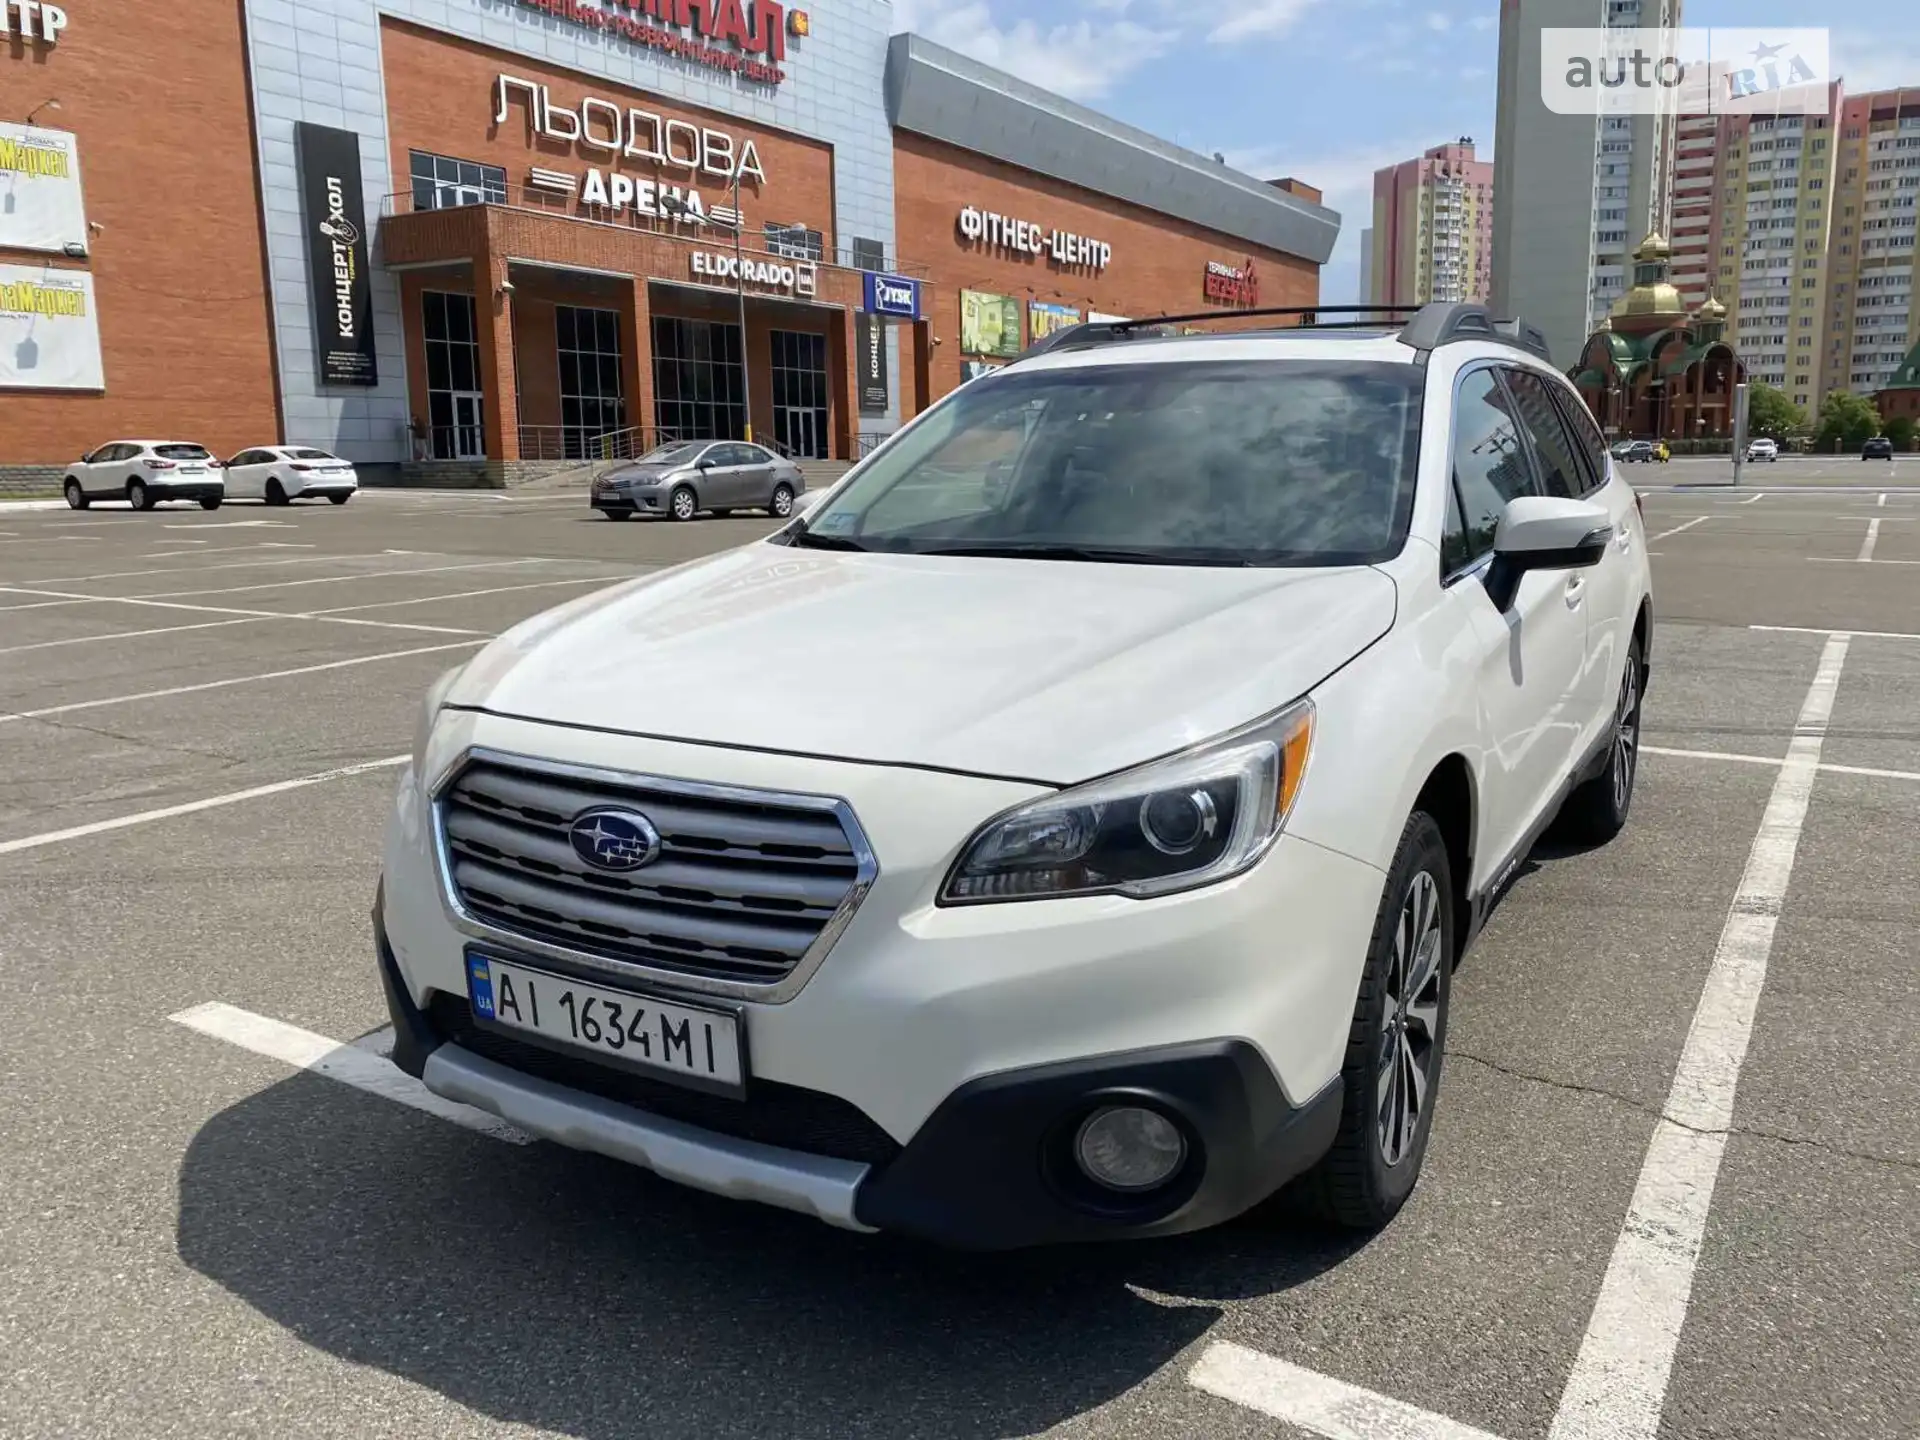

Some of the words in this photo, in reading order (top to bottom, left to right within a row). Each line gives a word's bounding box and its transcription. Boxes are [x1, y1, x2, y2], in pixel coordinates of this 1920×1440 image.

[496, 73, 767, 184] ЛЬОДОВА
[326, 177, 344, 222] ХОЛ
[583, 168, 706, 225] АРЕНА
[960, 206, 1112, 269] ФІТНЕС-ЦЕНТР
[332, 240, 354, 338] КОНЦЕРТ
[692, 252, 795, 286] ELDORADO
[884, 286, 912, 305] JYSK
[477, 995, 492, 1011] UA
[499, 973, 539, 1027] AI
